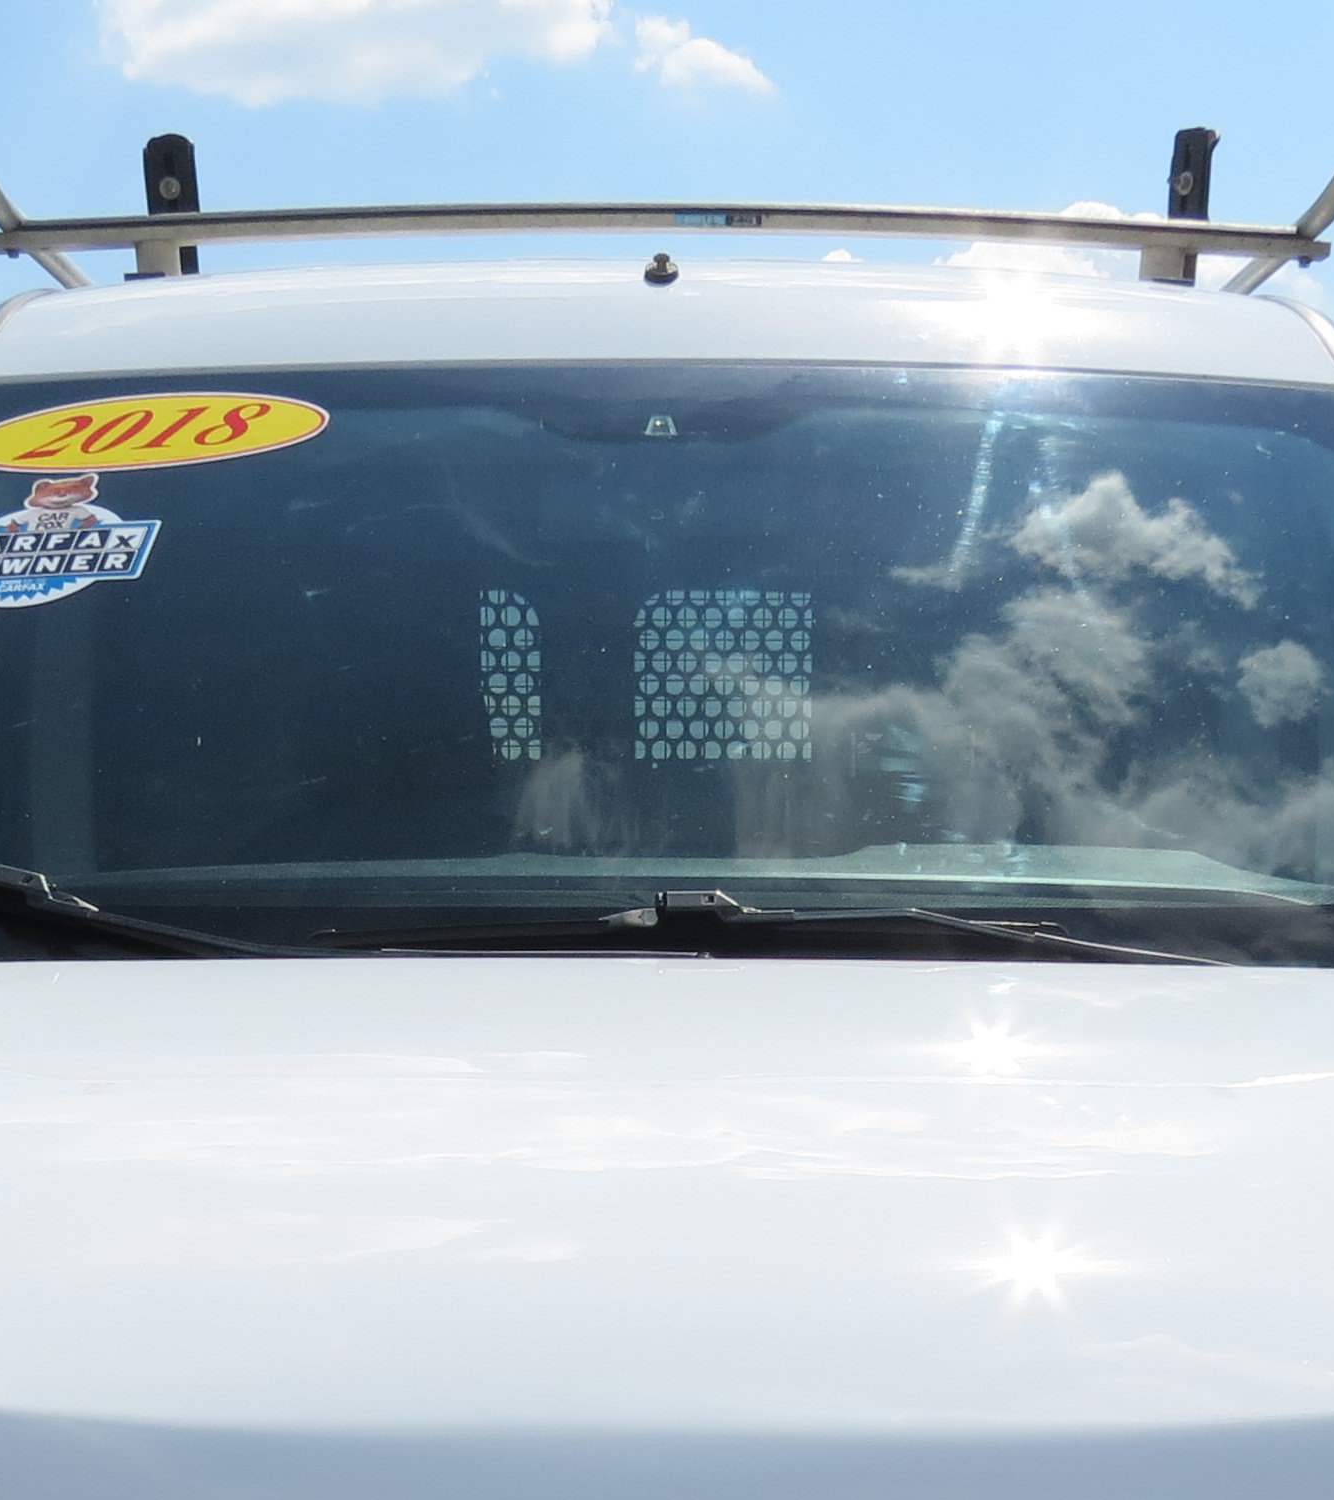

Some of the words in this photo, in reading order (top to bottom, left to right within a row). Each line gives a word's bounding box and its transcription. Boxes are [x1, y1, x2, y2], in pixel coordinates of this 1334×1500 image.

[12, 403, 271, 461] 2018
[37, 512, 69, 523] CAR
[35, 521, 65, 531] FOX
